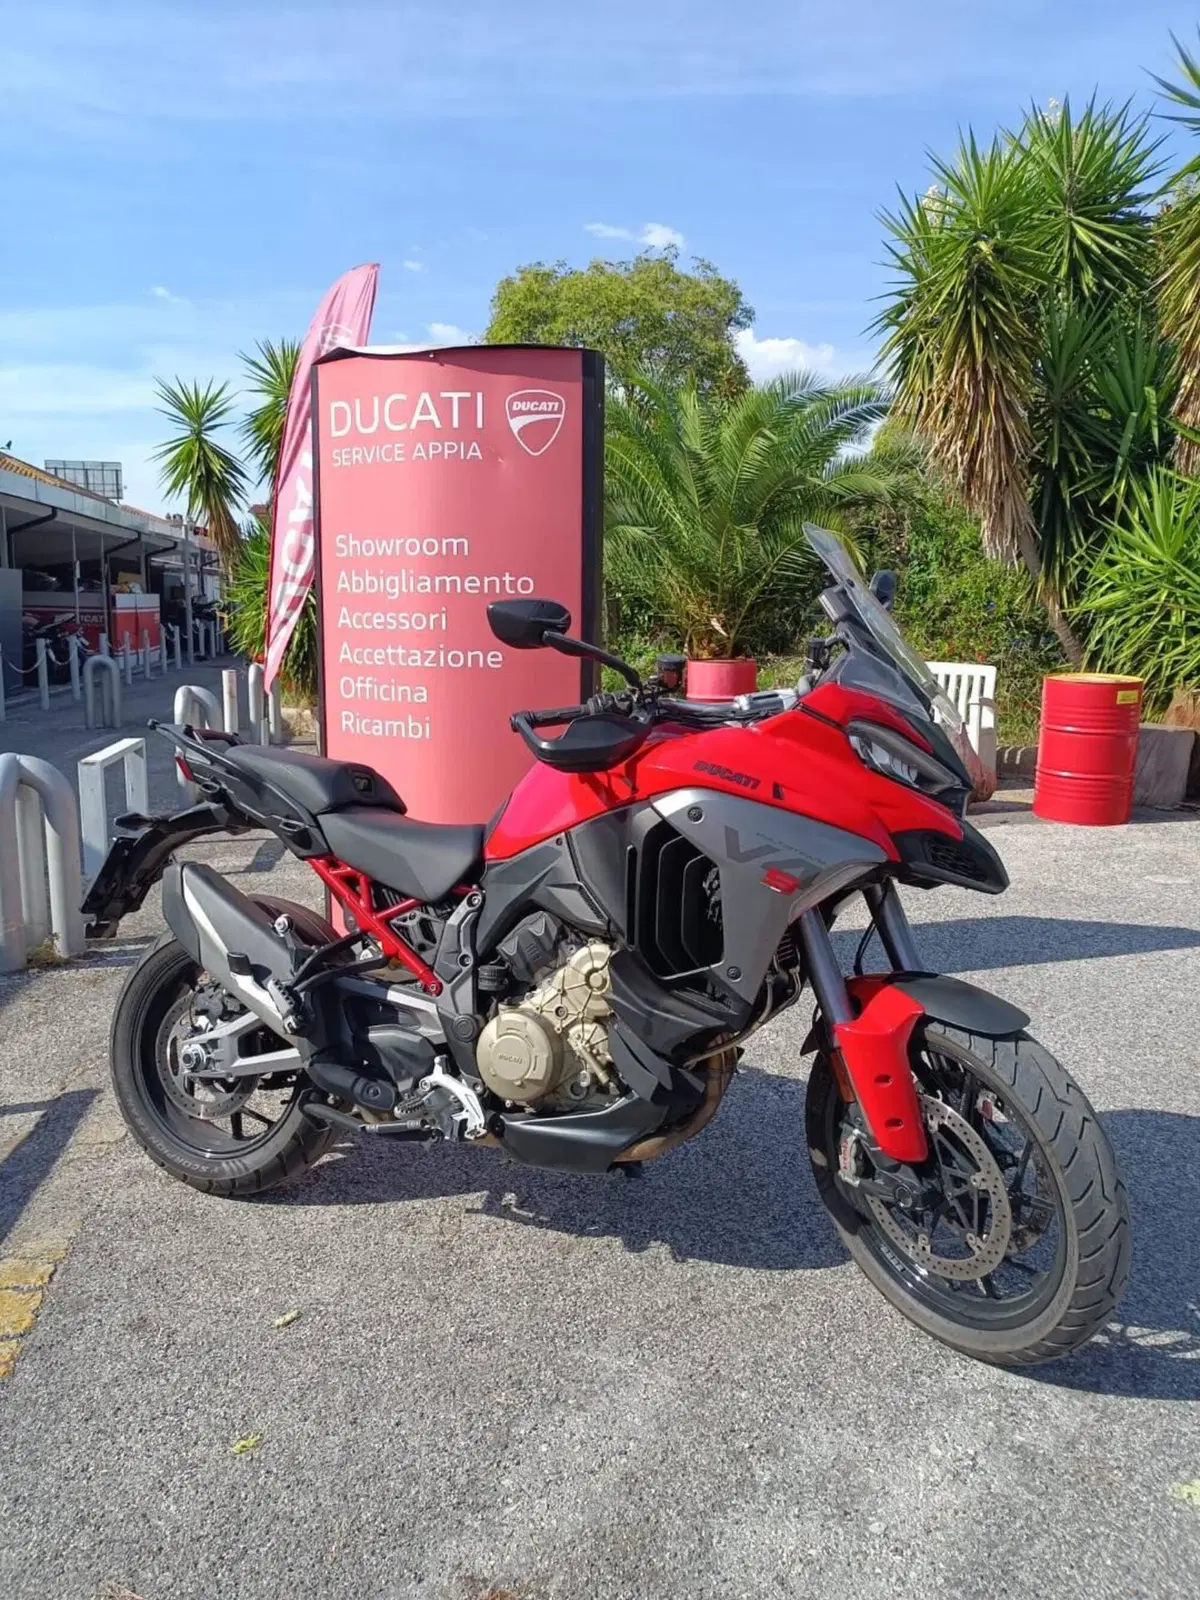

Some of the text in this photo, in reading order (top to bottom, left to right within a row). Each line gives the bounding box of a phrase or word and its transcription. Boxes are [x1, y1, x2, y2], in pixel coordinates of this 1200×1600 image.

[330, 391, 483, 437] DUCATI
[511, 401, 560, 412] DUCATI
[332, 441, 483, 467] SERVICE APPIA
[335, 533, 469, 557] Showroom
[336, 568, 534, 600] Abbigliamento
[338, 606, 447, 630] Accessori
[339, 641, 503, 668] Accettazione
[340, 676, 428, 703] Officina
[341, 711, 431, 739] Ricambi
[693, 760, 761, 790] DUCATI
